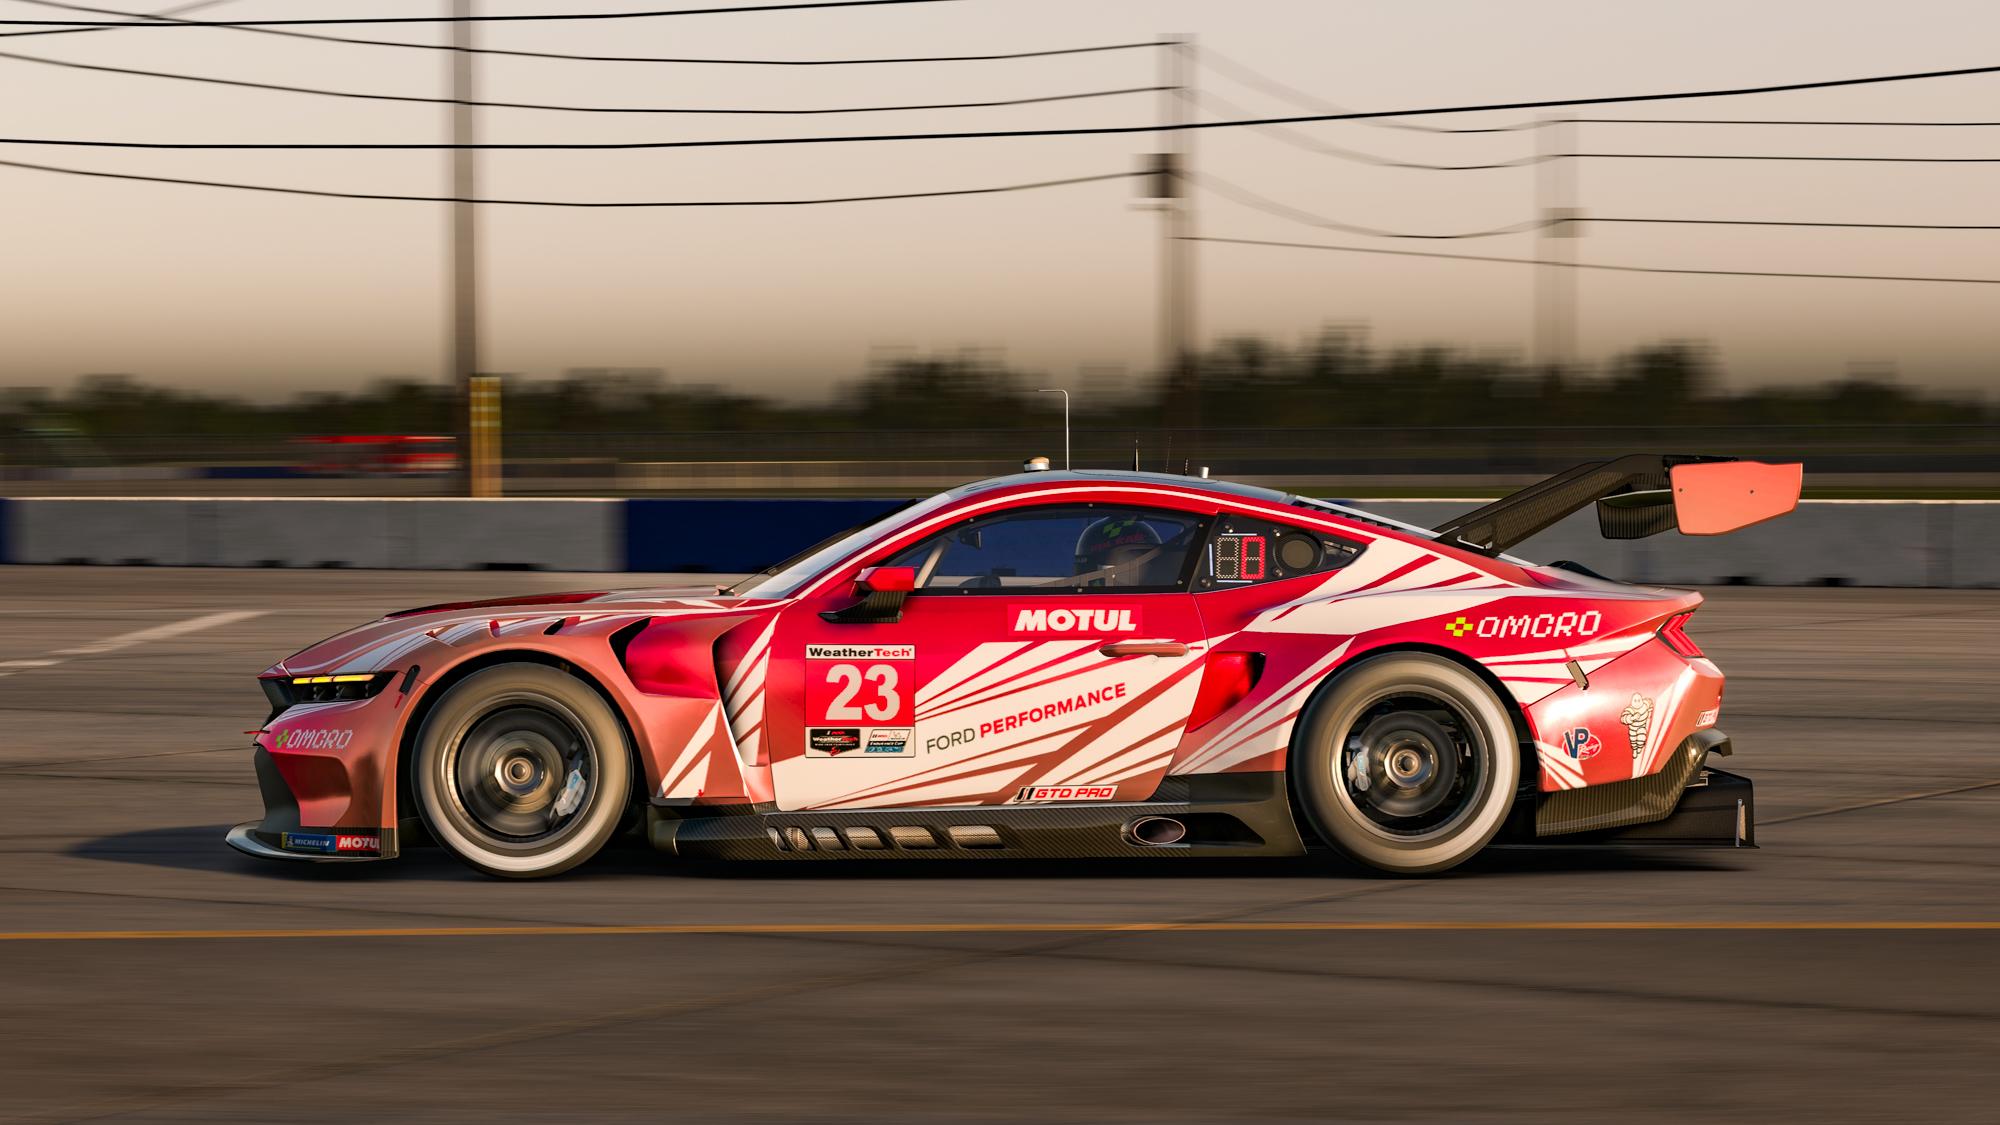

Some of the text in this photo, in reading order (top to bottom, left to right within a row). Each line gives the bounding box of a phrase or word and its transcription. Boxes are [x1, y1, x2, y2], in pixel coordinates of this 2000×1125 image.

[1014, 608, 1137, 632] MOTUL
[1476, 610, 1602, 638] OMCRO
[809, 647, 911, 657] WeatherTech
[825, 663, 901, 721] 23
[926, 682, 1127, 754] FORD PERFORMANCE
[286, 728, 353, 749] OMCRO
[1563, 727, 1590, 759] VP
[1035, 788, 1113, 799] GTD PRO
[294, 838, 330, 847] MICHELIN
